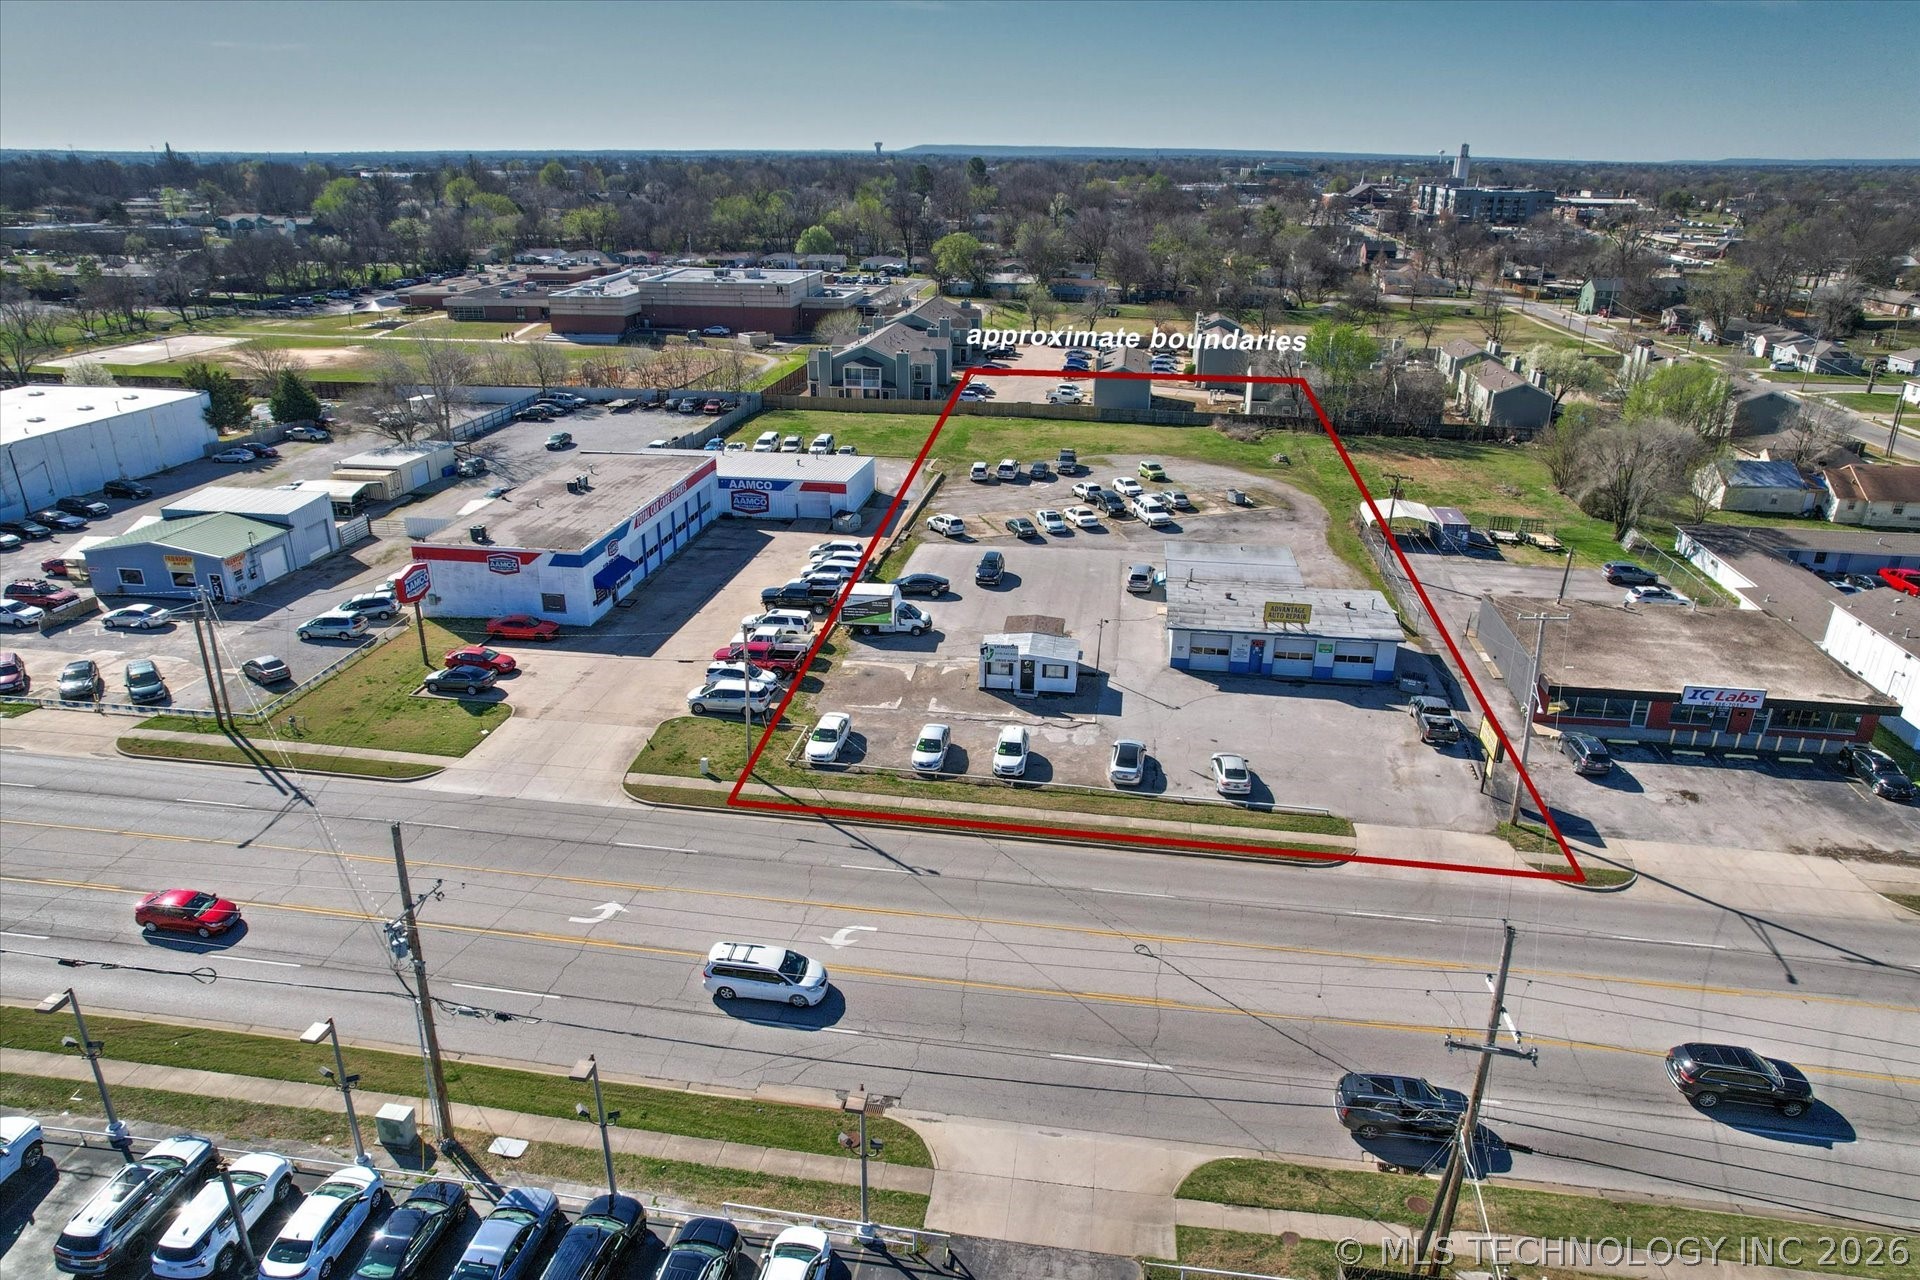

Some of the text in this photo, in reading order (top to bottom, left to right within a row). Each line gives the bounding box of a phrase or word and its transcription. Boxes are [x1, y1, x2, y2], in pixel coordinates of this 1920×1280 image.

[729, 479, 773, 490] AAMCO
[733, 497, 768, 506] AAMCO
[489, 561, 518, 569] AAMCO
[405, 572, 429, 594] AAMCO
[1270, 605, 1306, 613] ADVANTAGE
[1688, 689, 1760, 703] IC Labs
